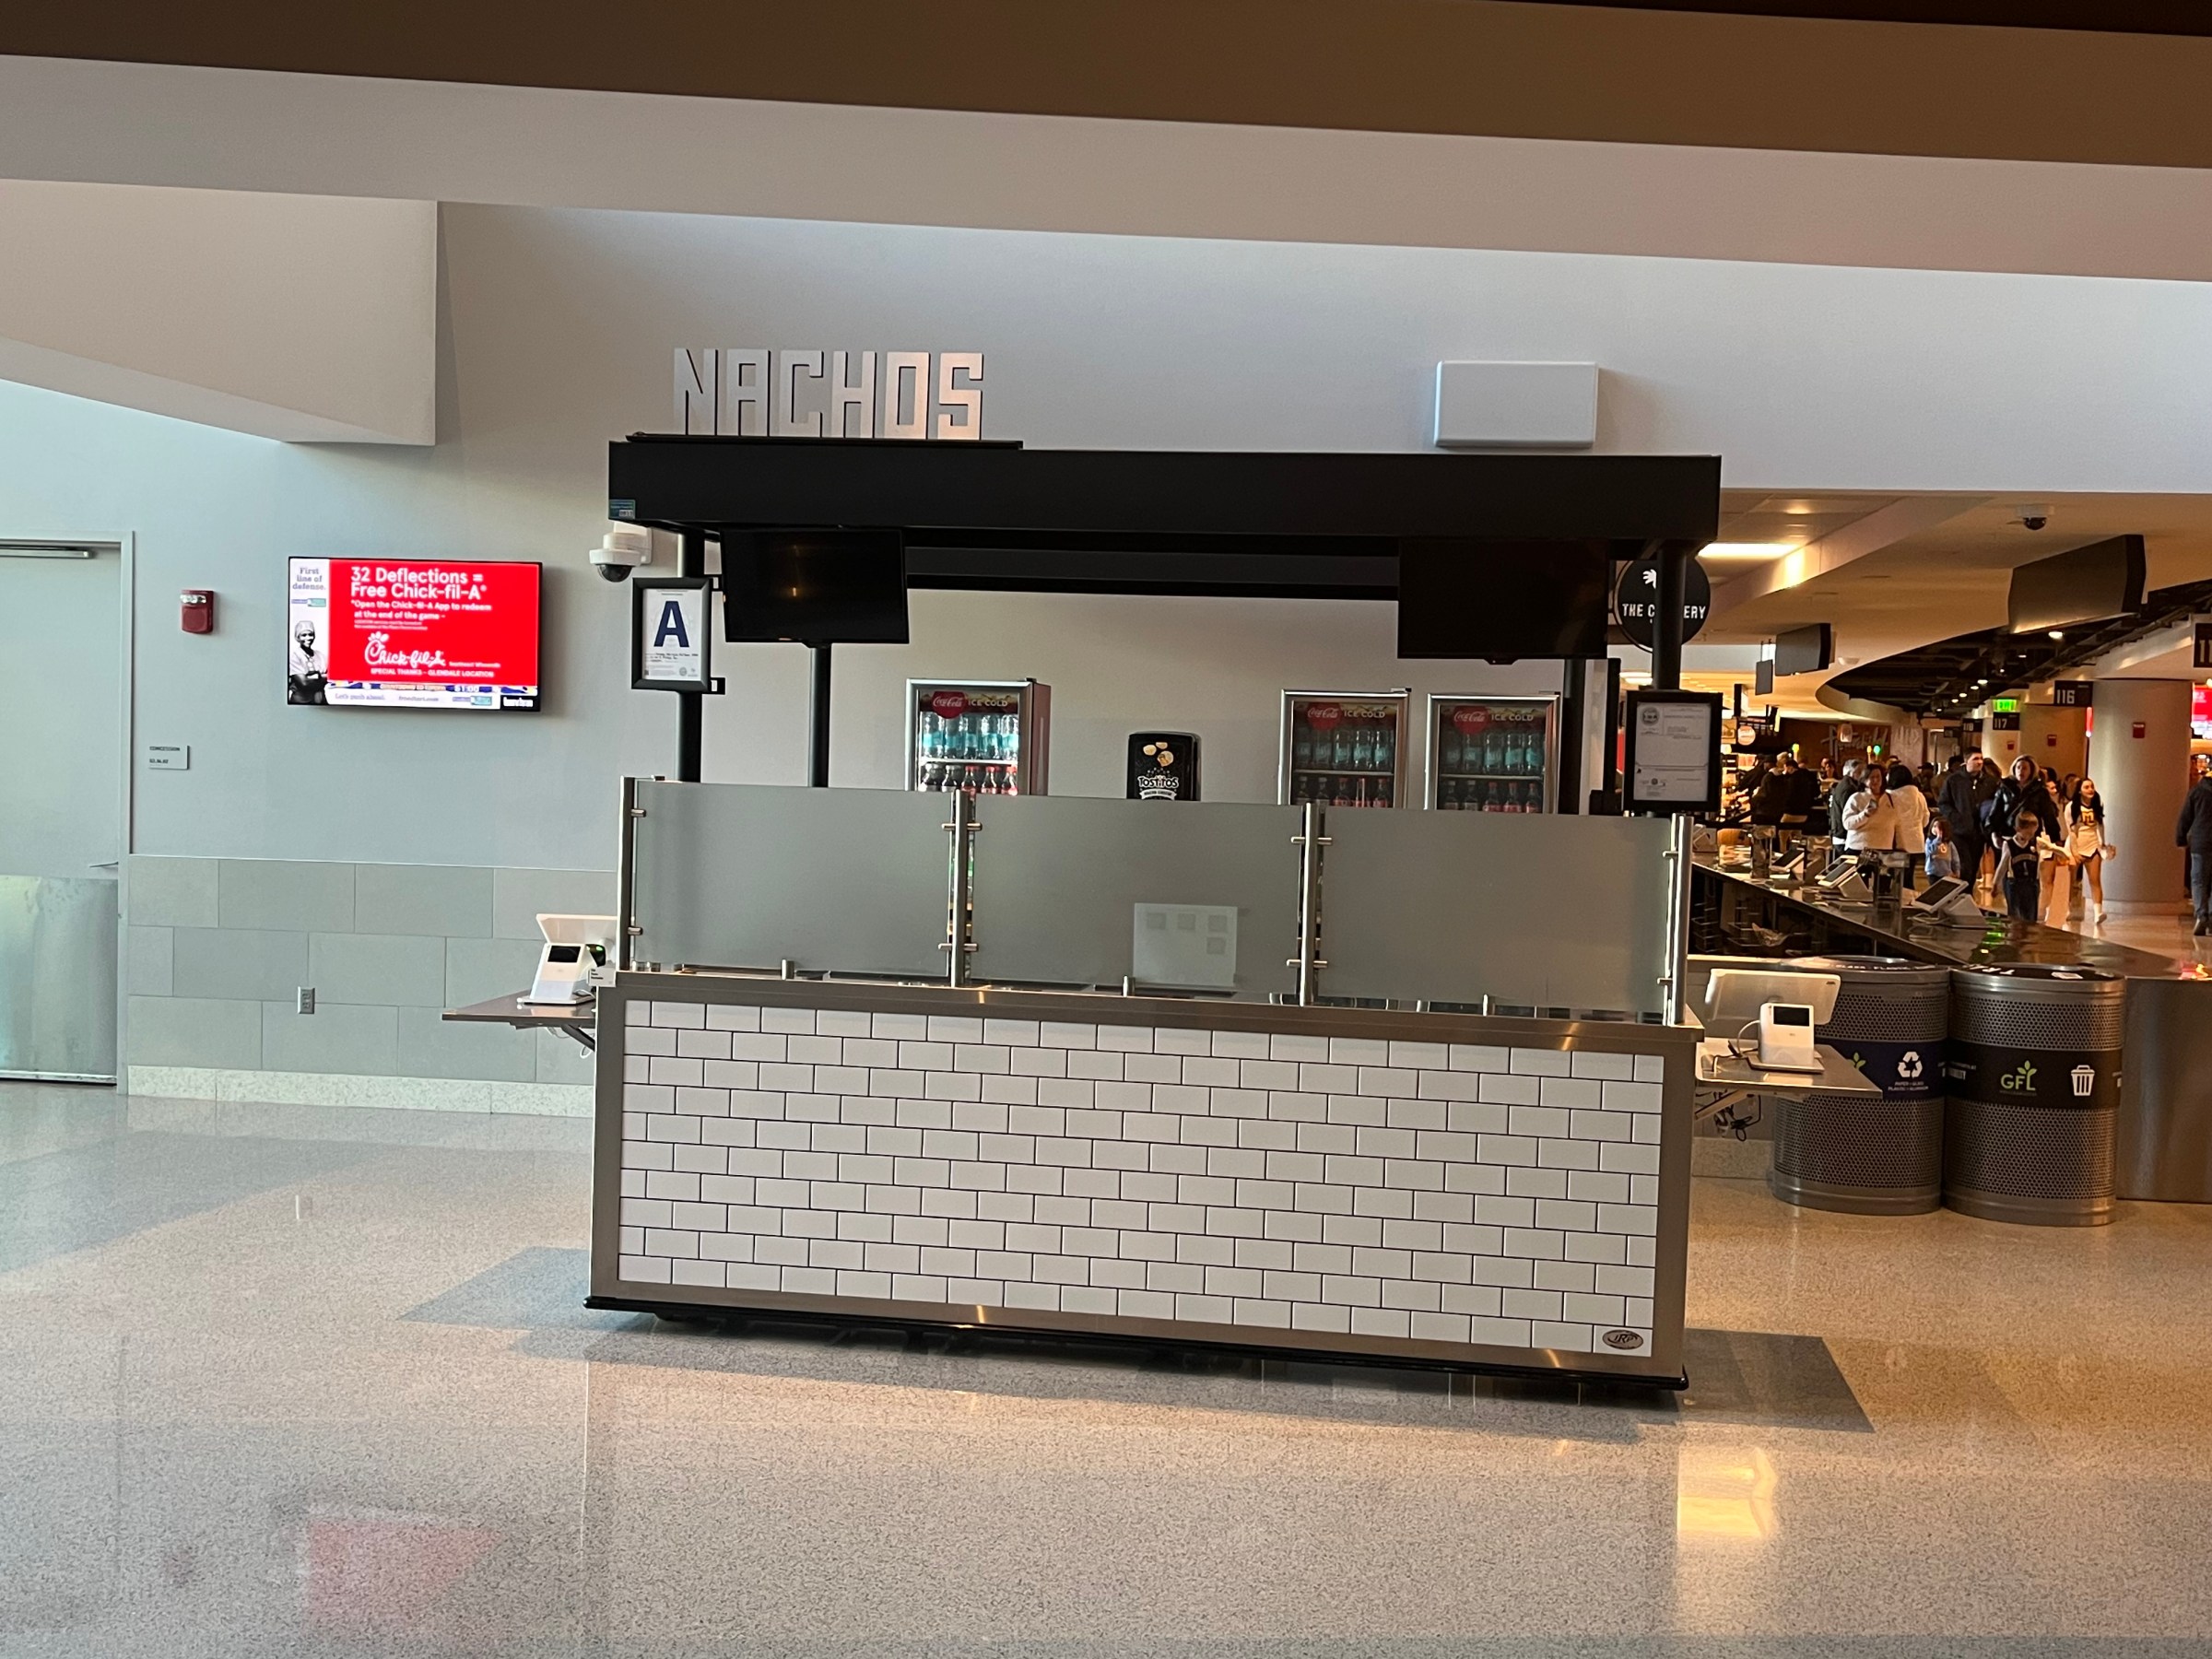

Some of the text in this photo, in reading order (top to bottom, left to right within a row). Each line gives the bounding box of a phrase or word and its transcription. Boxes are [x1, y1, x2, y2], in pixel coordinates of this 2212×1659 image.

[673, 347, 983, 441] NACHOS
[350, 566, 371, 582] 32
[375, 567, 468, 584] Deflections
[350, 582, 387, 598] Free
[376, 600, 390, 608] the
[434, 602, 450, 611] App
[451, 602, 460, 610] to
[1622, 603, 1643, 617] THE
[363, 610, 377, 618] the
[378, 610, 393, 618] end
[394, 610, 403, 618] of
[418, 612, 440, 621] game
[653, 600, 690, 647] A
[932, 696, 963, 707] Coca-Cola
[2056, 689, 2076, 704] 116
[1508, 713, 1534, 722] COLD
[1994, 718, 2007, 729] 117
[2081, 810, 2094, 823] M
[2000, 1065, 2036, 1091] GFL
